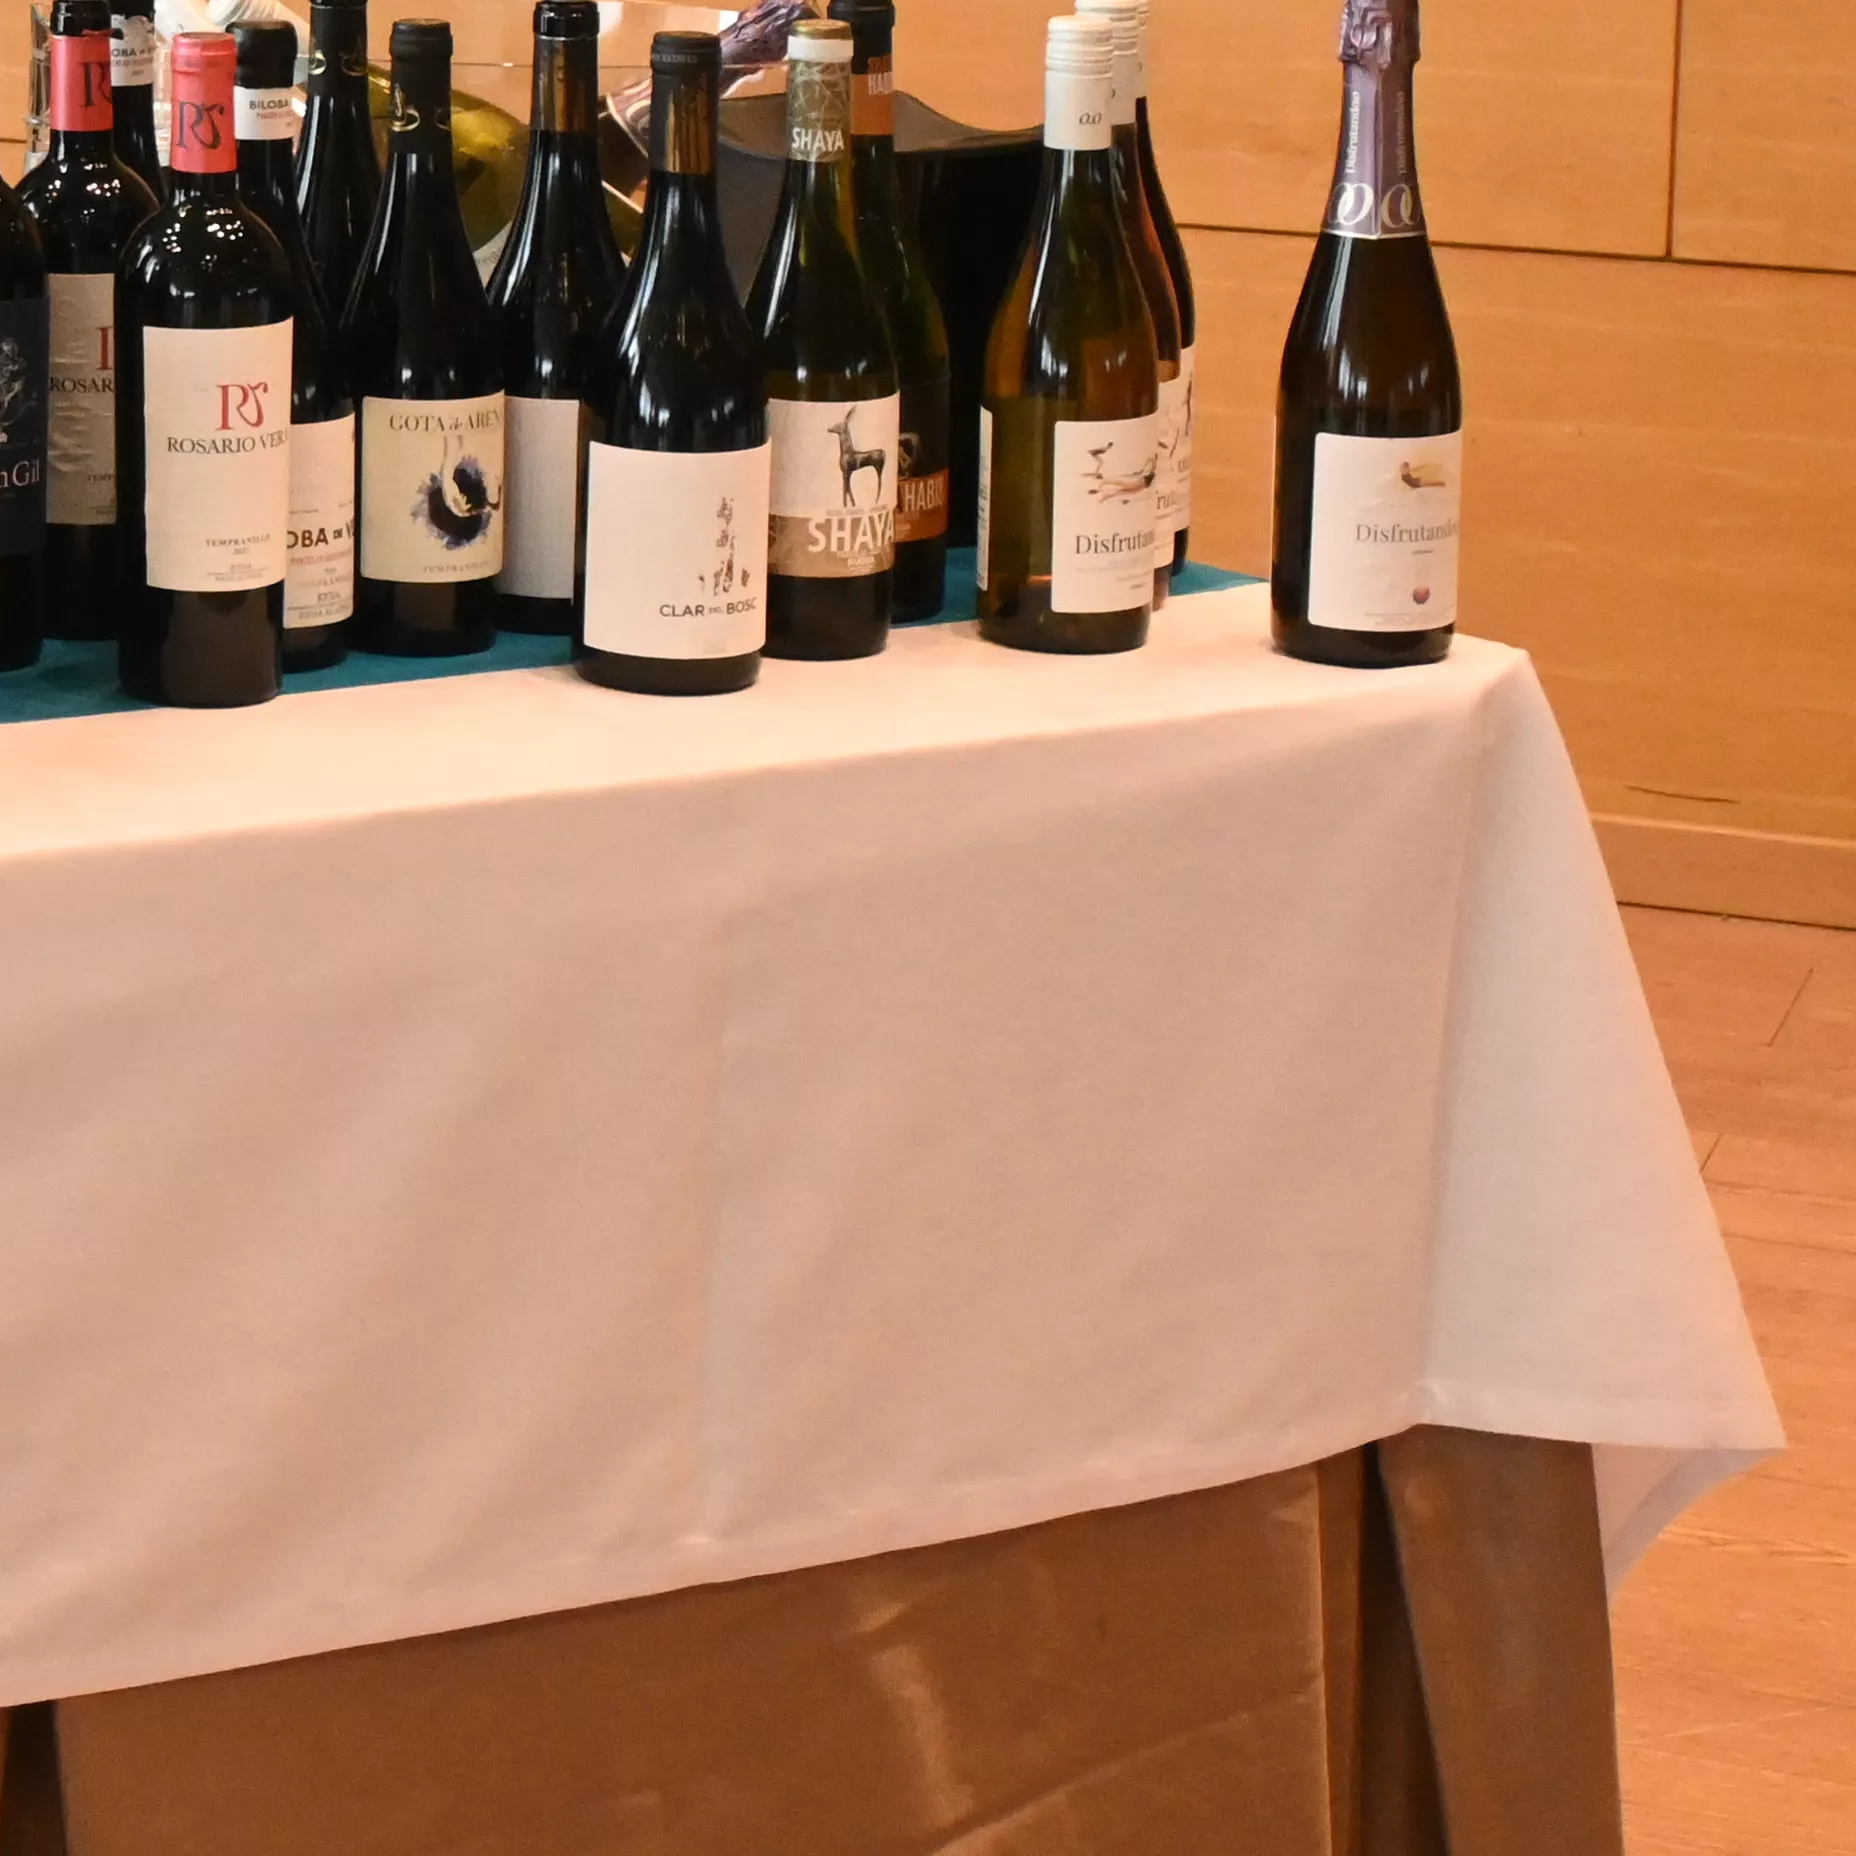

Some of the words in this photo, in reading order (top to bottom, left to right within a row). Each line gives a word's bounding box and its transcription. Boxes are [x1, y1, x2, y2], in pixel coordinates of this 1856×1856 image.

[792, 127, 845, 152] SHAYA
[49, 377, 115, 394] ROSAR
[389, 413, 445, 433] GOTA
[167, 436, 256, 455] ROSARIO
[205, 533, 270, 547] TEMPRANILLO
[808, 510, 894, 553] SHAYA
[659, 604, 705, 618] CLAR
[726, 597, 758, 615] BOSC
